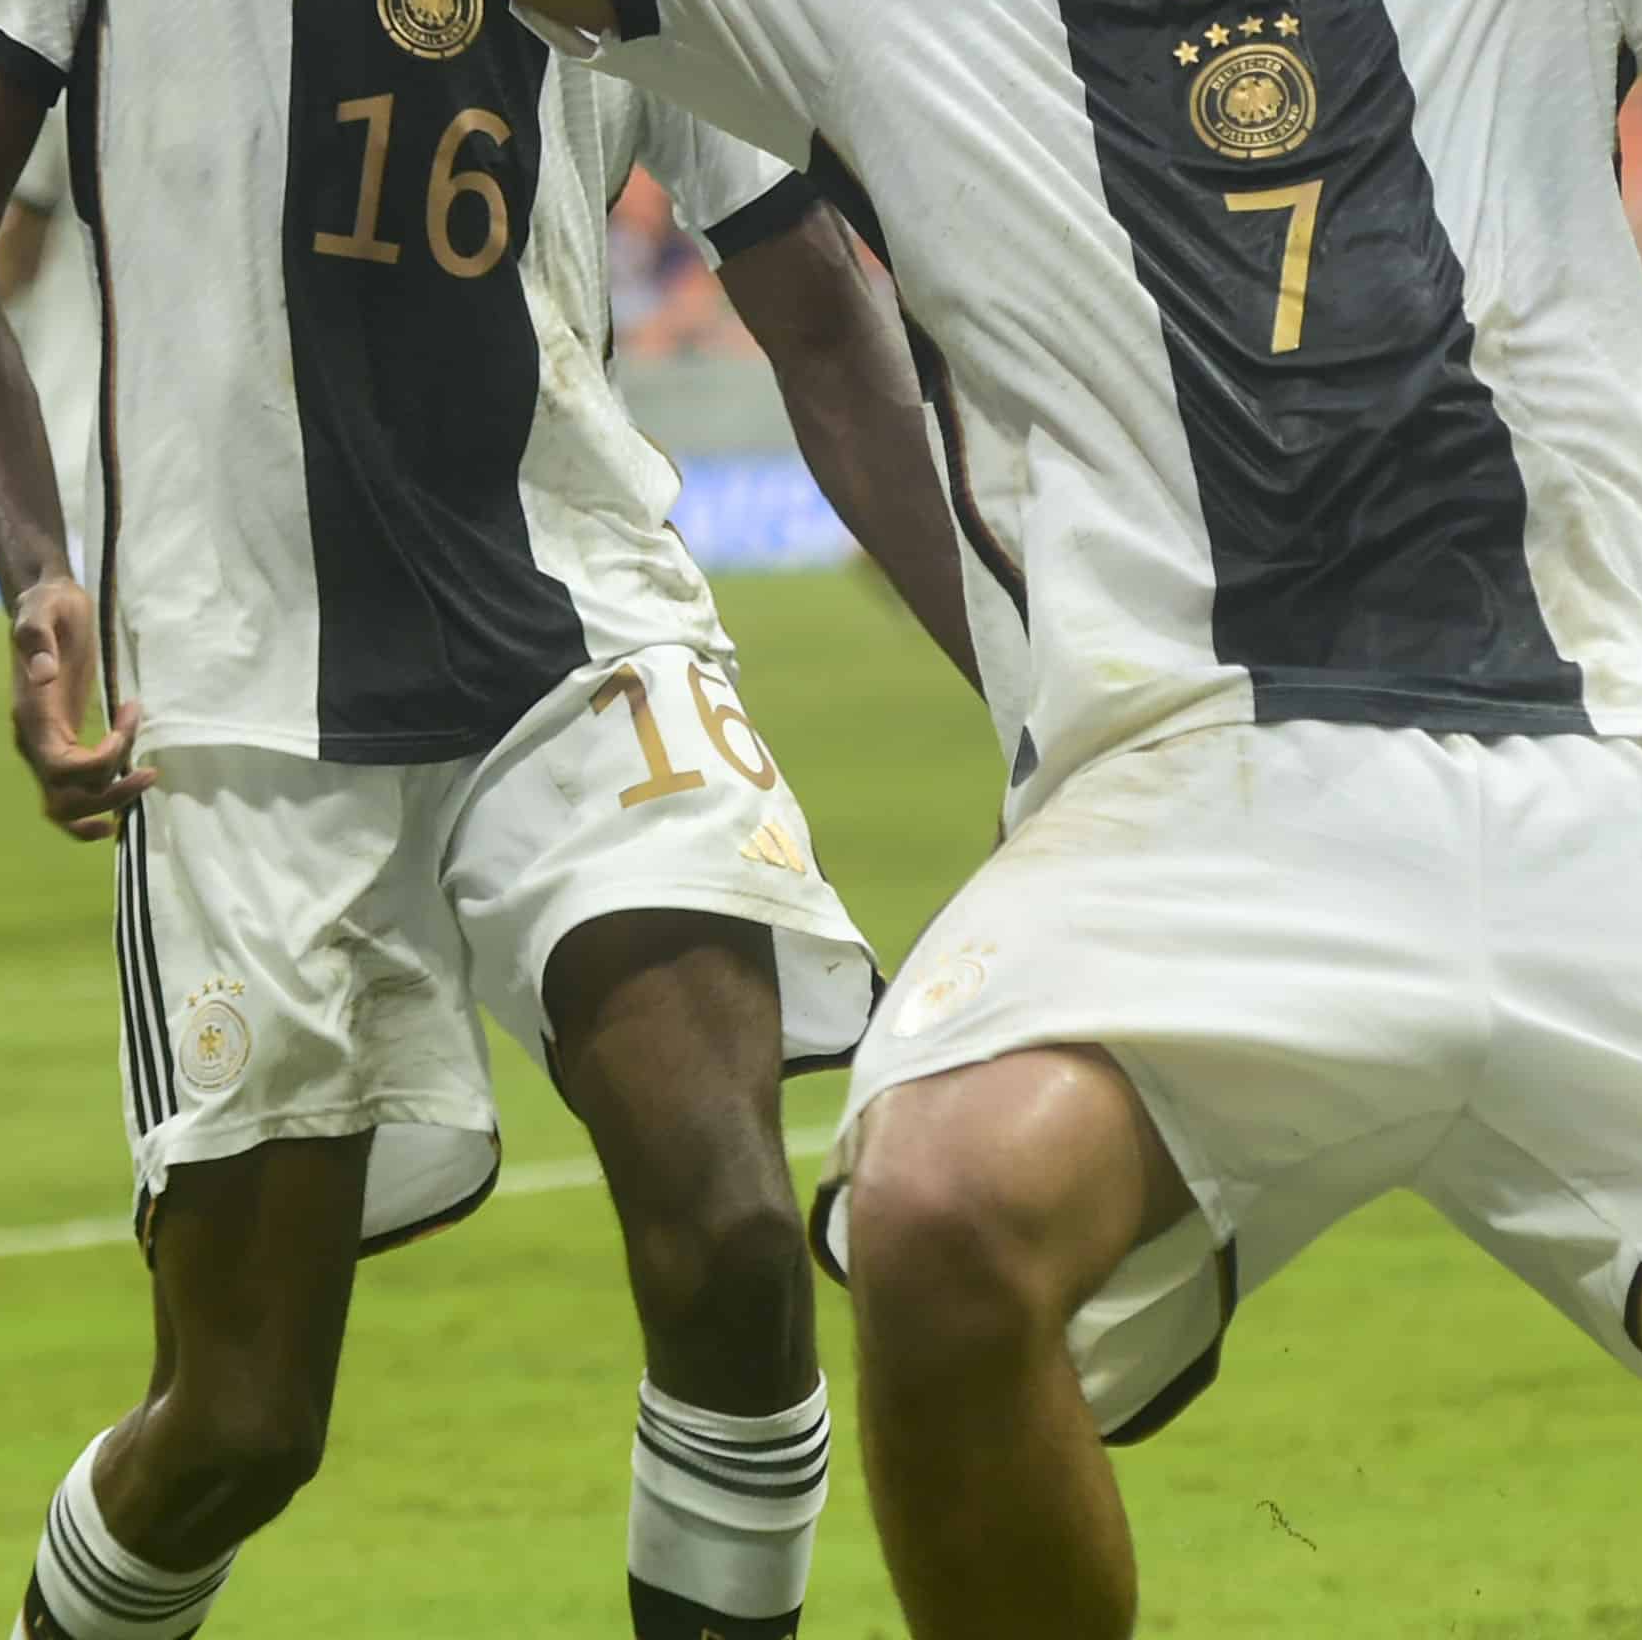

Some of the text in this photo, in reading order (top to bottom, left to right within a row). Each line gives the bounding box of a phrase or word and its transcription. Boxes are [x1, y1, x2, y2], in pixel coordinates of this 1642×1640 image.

[313, 93, 512, 278] 16
[1223, 180, 1323, 355] 7
[589, 661, 777, 809] 16
